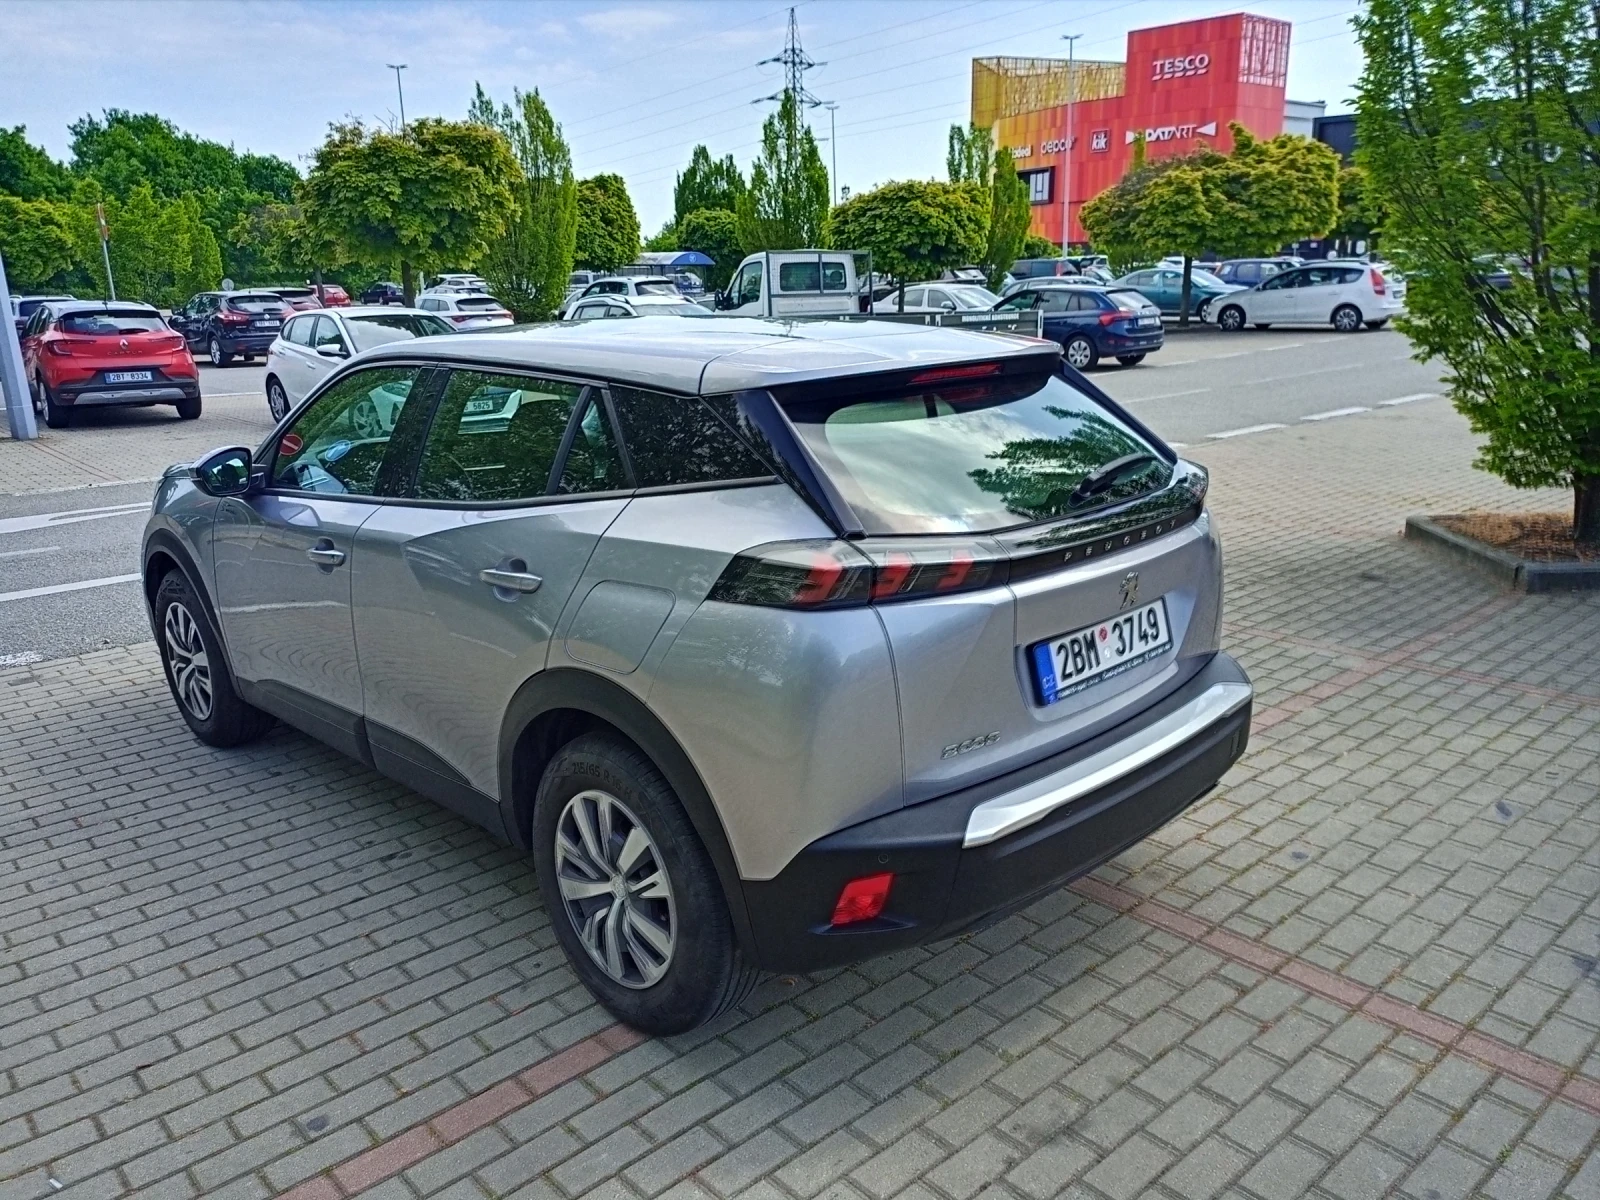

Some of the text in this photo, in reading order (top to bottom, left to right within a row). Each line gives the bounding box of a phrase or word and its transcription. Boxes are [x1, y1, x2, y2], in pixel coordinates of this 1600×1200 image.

[1152, 54, 1209, 74] TESCO
[1145, 124, 1197, 142] DATART
[111, 373, 125, 381] 2BT
[1064, 519, 1176, 562] PEUGEOT
[1056, 630, 1101, 682] 2BM
[1112, 607, 1160, 656] 3749
[572, 762, 601, 777] 215/65
